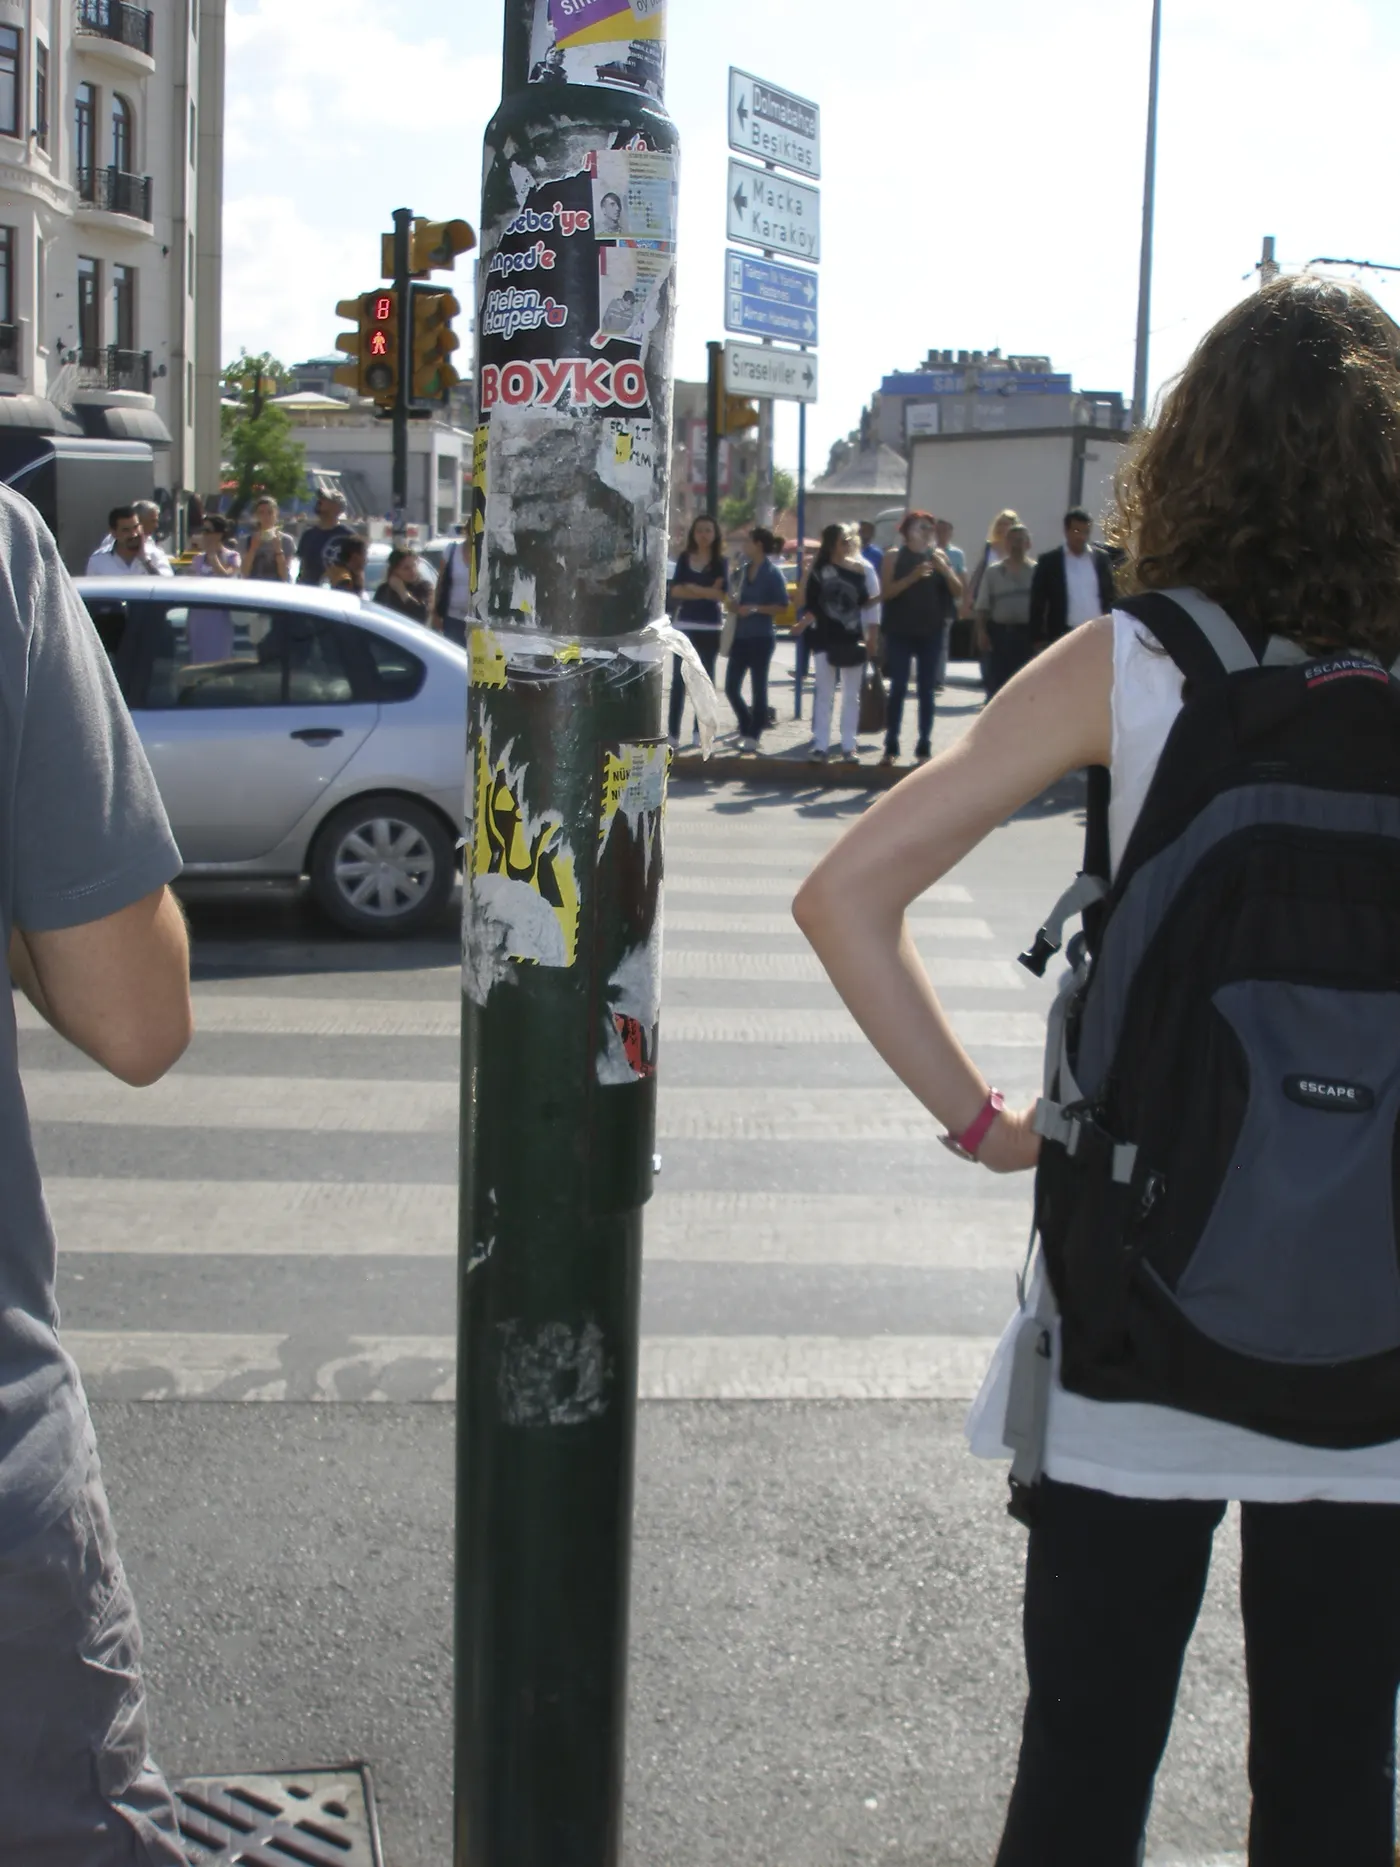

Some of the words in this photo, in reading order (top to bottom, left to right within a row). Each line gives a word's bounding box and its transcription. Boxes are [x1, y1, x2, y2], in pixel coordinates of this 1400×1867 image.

[752, 210, 816, 255] Karaköy
[486, 286, 540, 312] Helen
[483, 297, 568, 340] Harper'a
[481, 358, 649, 412] BOYKO
[1305, 661, 1360, 679] ESCAPE
[1299, 1081, 1356, 1099] ESCAPE
